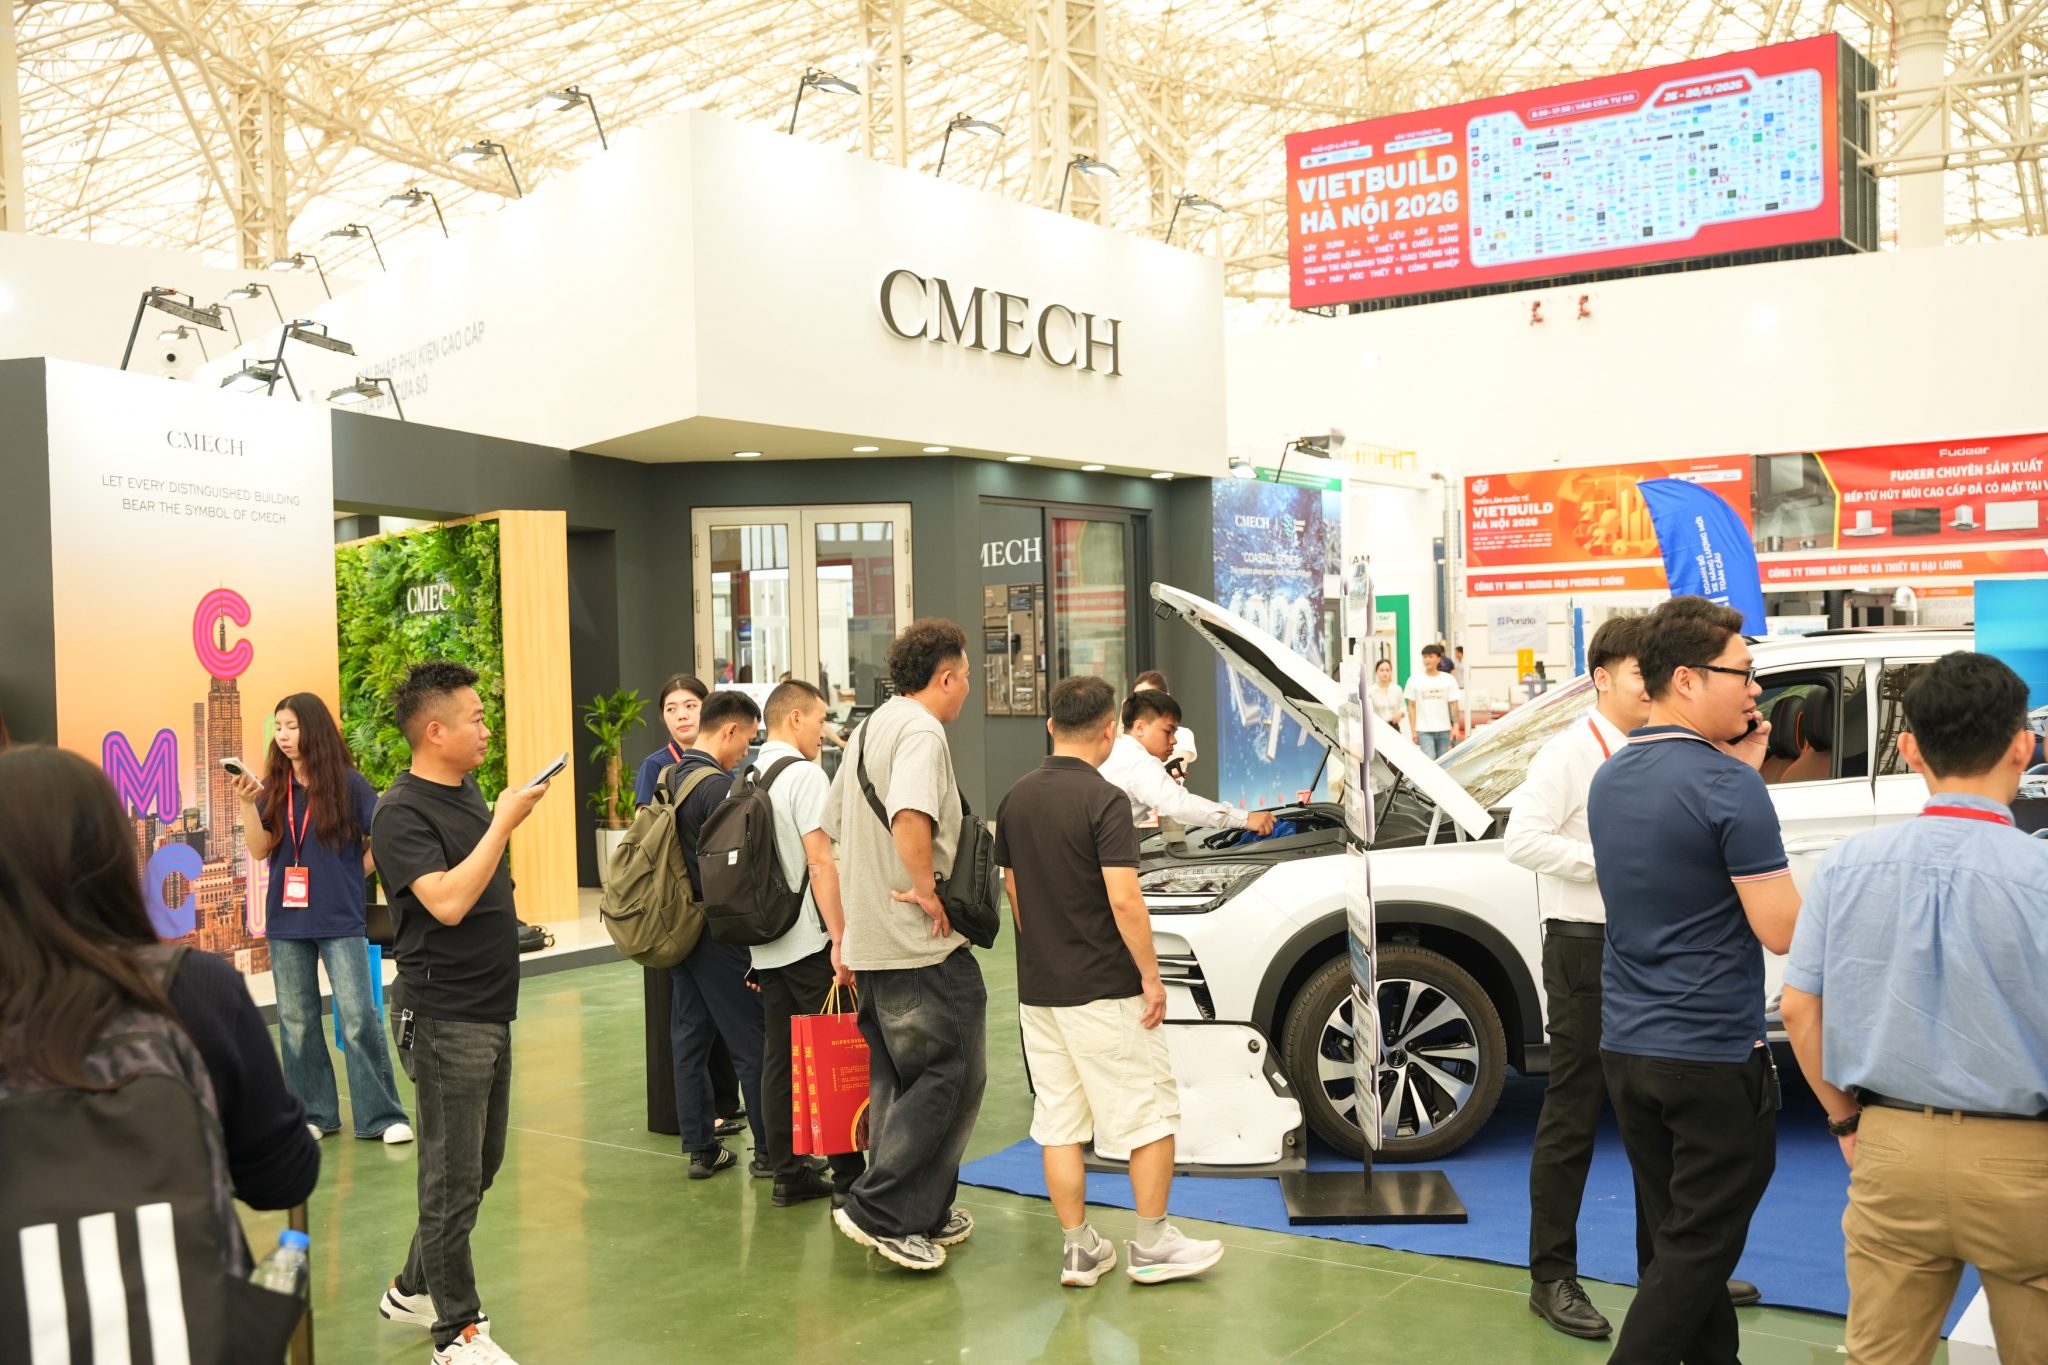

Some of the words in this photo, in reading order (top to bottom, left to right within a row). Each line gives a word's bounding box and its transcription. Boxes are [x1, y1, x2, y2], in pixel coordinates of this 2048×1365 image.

[1297, 154, 1459, 203] VIETBUILD
[1300, 202, 1337, 235] HÀ
[1342, 195, 1389, 231] NỘI
[1394, 189, 1459, 220] 2026
[879, 268, 1122, 378] CMECH
[166, 429, 244, 456] CMECH
[1939, 446, 1990, 457] Fudeer
[1890, 469, 1934, 482] FUDEER
[1936, 463, 1983, 479] CHUYÊN
[1985, 460, 2010, 475] SẢN
[2012, 457, 2044, 473] XUẤT
[102, 474, 123, 488] LET
[128, 477, 165, 491] EVERY
[169, 481, 250, 501] DISTINGUISHED
[254, 491, 300, 506] BUILDING
[122, 498, 155, 511] BEAR
[159, 501, 181, 515] THE
[185, 503, 230, 519] SYMBOL
[233, 508, 247, 520] OF
[250, 510, 286, 524] CMECH
[1234, 514, 1270, 529] CMECH
[1472, 502, 1554, 518] VIETBUILD
[1472, 519, 1489, 530] HÀ
[1490, 517, 1510, 530] NỘI
[1512, 518, 1538, 527] 2026
[1696, 554, 1705, 566] SỐ
[1768, 566, 1791, 578] CÔNG
[1793, 567, 1803, 577] TY
[1805, 566, 1827, 576] TNHH
[1828, 563, 1848, 575] MÁY
[1849, 562, 1869, 574] MÓC
[1871, 561, 1883, 573] VÀ
[1884, 560, 1907, 573] THIẾT
[1910, 563, 1919, 575] BỊ
[1921, 561, 1937, 573] ĐẠI
[1939, 559, 1963, 570] LONG
[1474, 580, 1494, 592] CÔNG
[1495, 582, 1503, 590] TY
[1505, 580, 1524, 590] TNHH
[1525, 578, 1553, 589] THƯƠNG
[1554, 578, 1568, 589] MẠI
[1569, 576, 1600, 587] PHƯƠNG
[1600, 574, 1625, 586] CHÍNH
[1700, 566, 1711, 595] DOANH
[407, 582, 455, 613] CMEC
[193, 588, 253, 680] C
[102, 728, 178, 824] M
